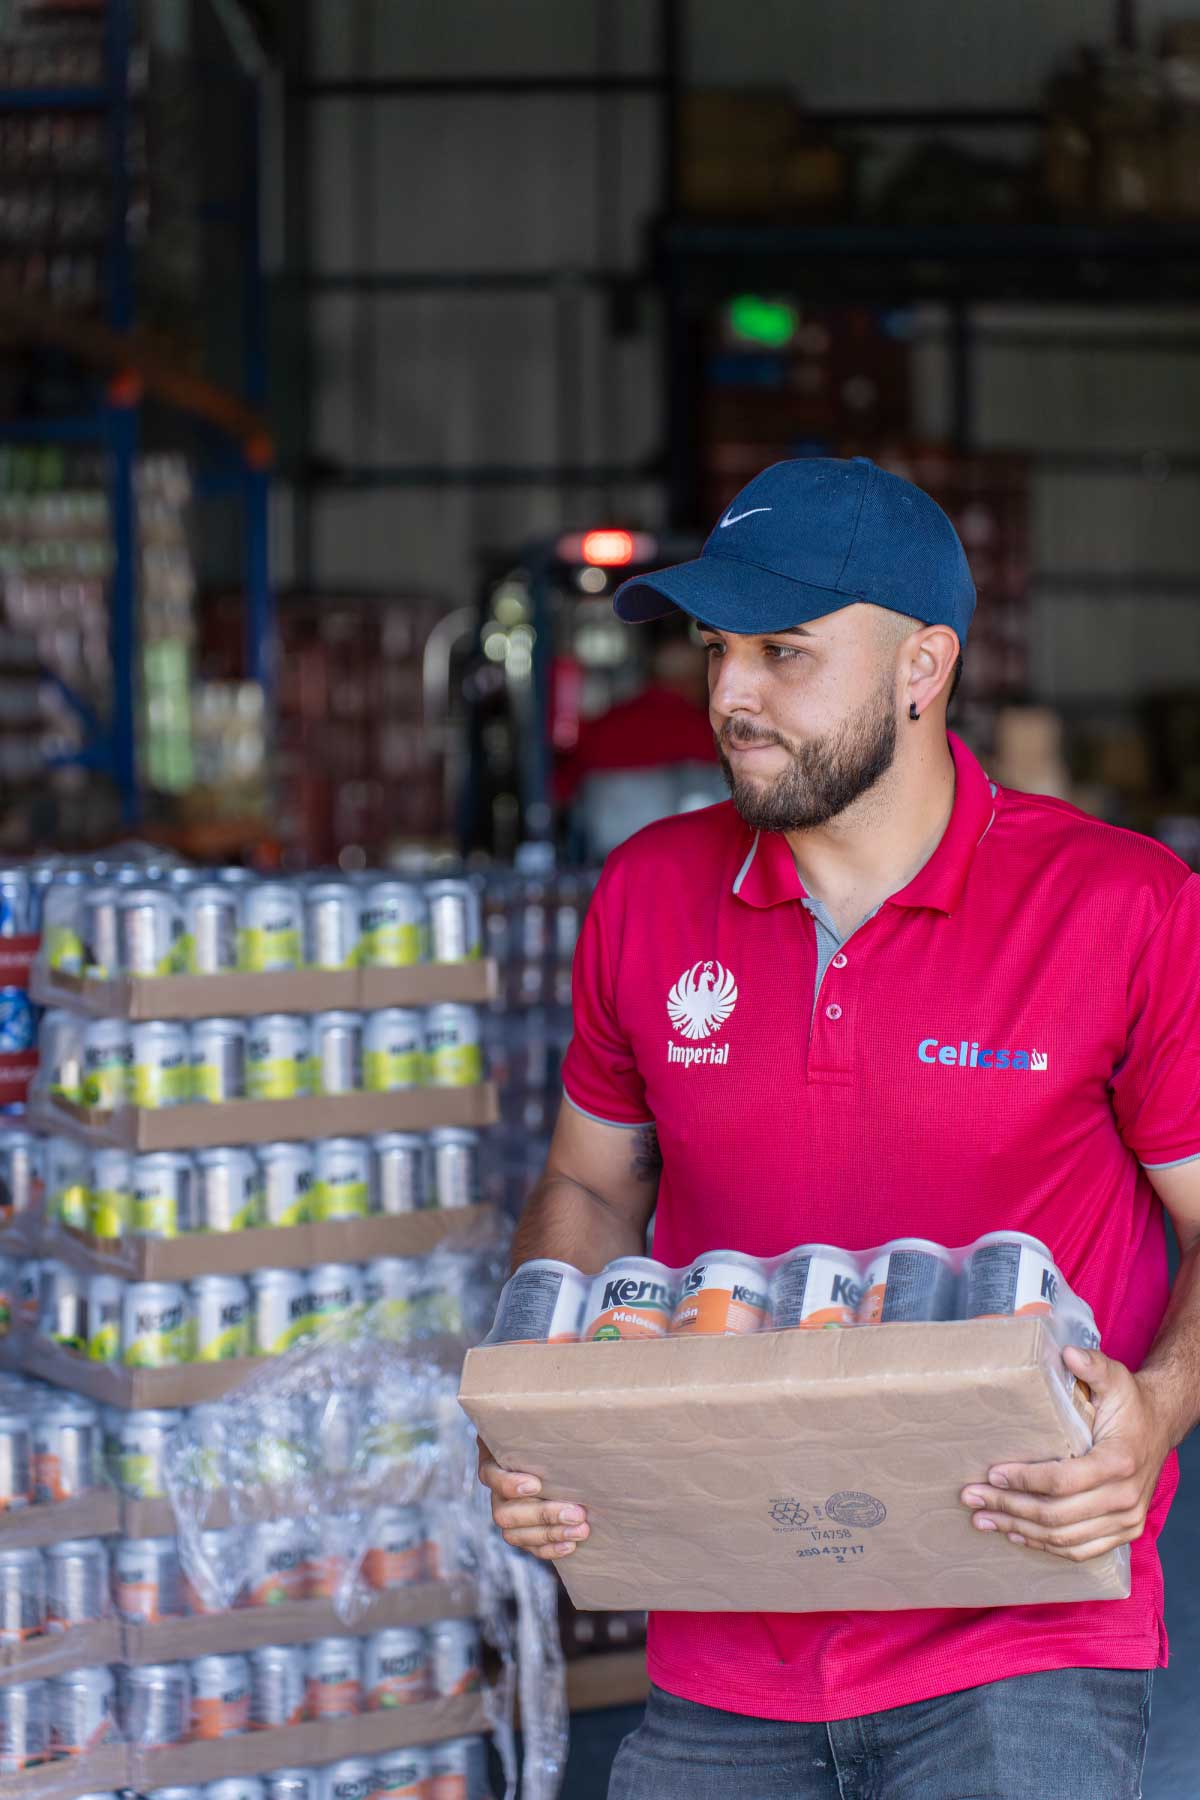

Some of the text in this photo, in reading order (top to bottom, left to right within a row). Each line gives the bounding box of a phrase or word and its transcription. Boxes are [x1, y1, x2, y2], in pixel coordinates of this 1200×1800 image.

[667, 1040, 730, 1069] Imperial
[918, 1038, 1030, 1070] Celicsa
[601, 1277, 668, 1310] Kern
[811, 1529, 852, 1541] 174758
[835, 1555, 846, 1564] 2
